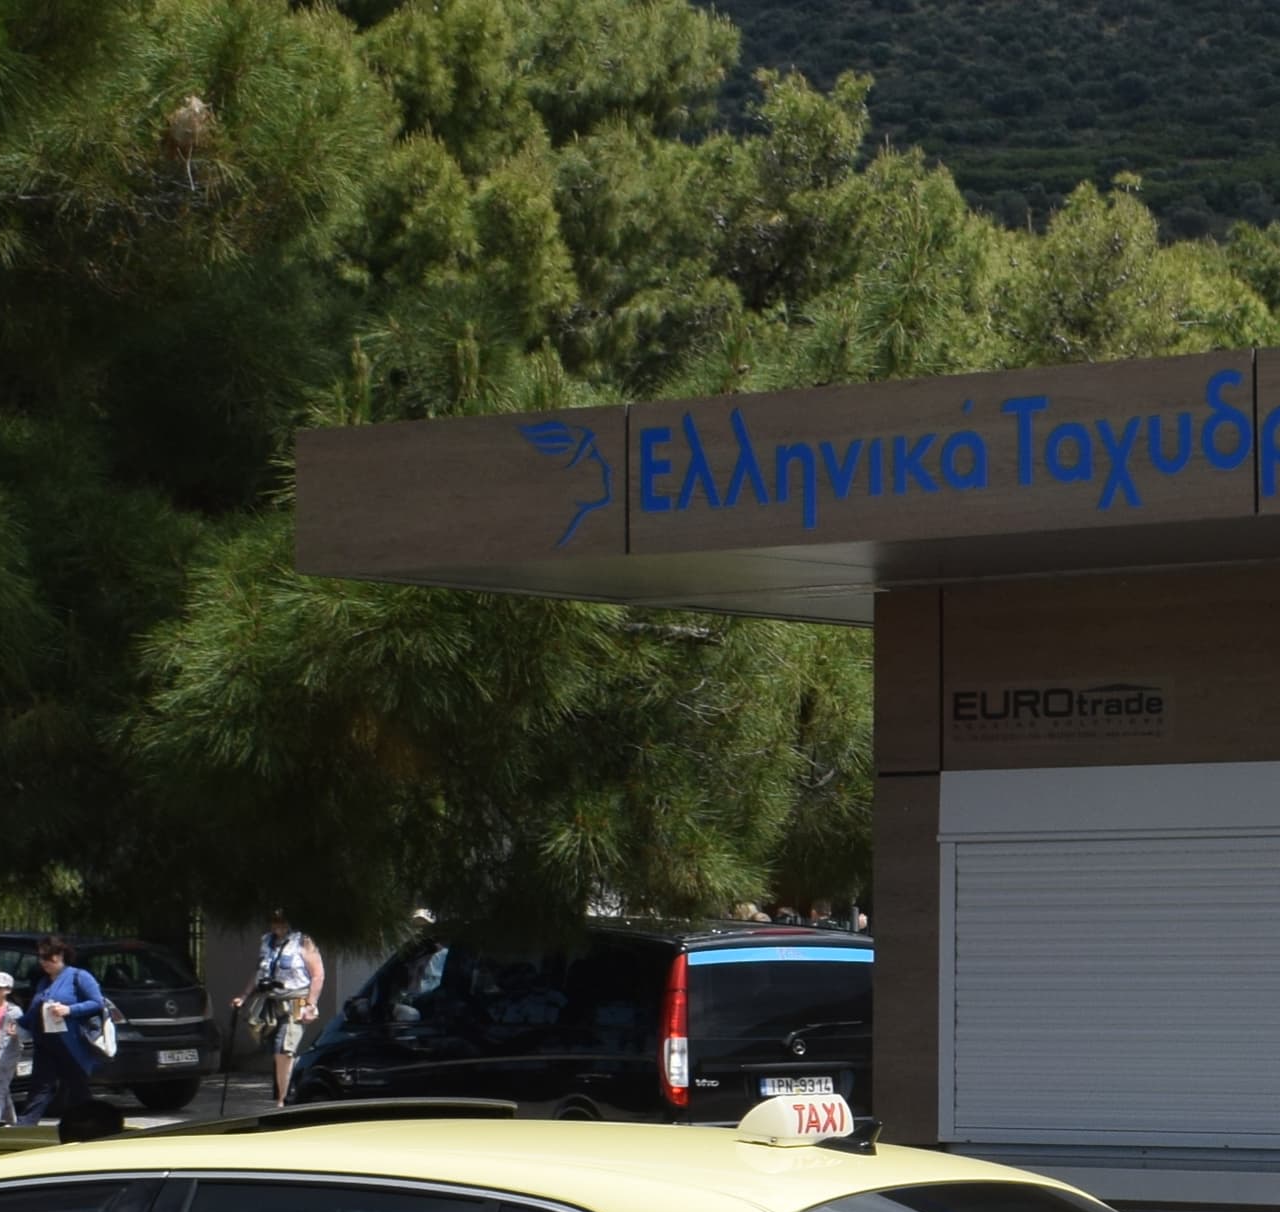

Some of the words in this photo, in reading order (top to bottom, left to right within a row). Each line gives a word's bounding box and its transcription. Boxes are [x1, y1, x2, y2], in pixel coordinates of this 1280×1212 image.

[639, 400, 988, 529] Ελληνικά
[952, 686, 1164, 721] EUROtrade
[792, 1102, 845, 1135] TAXI
